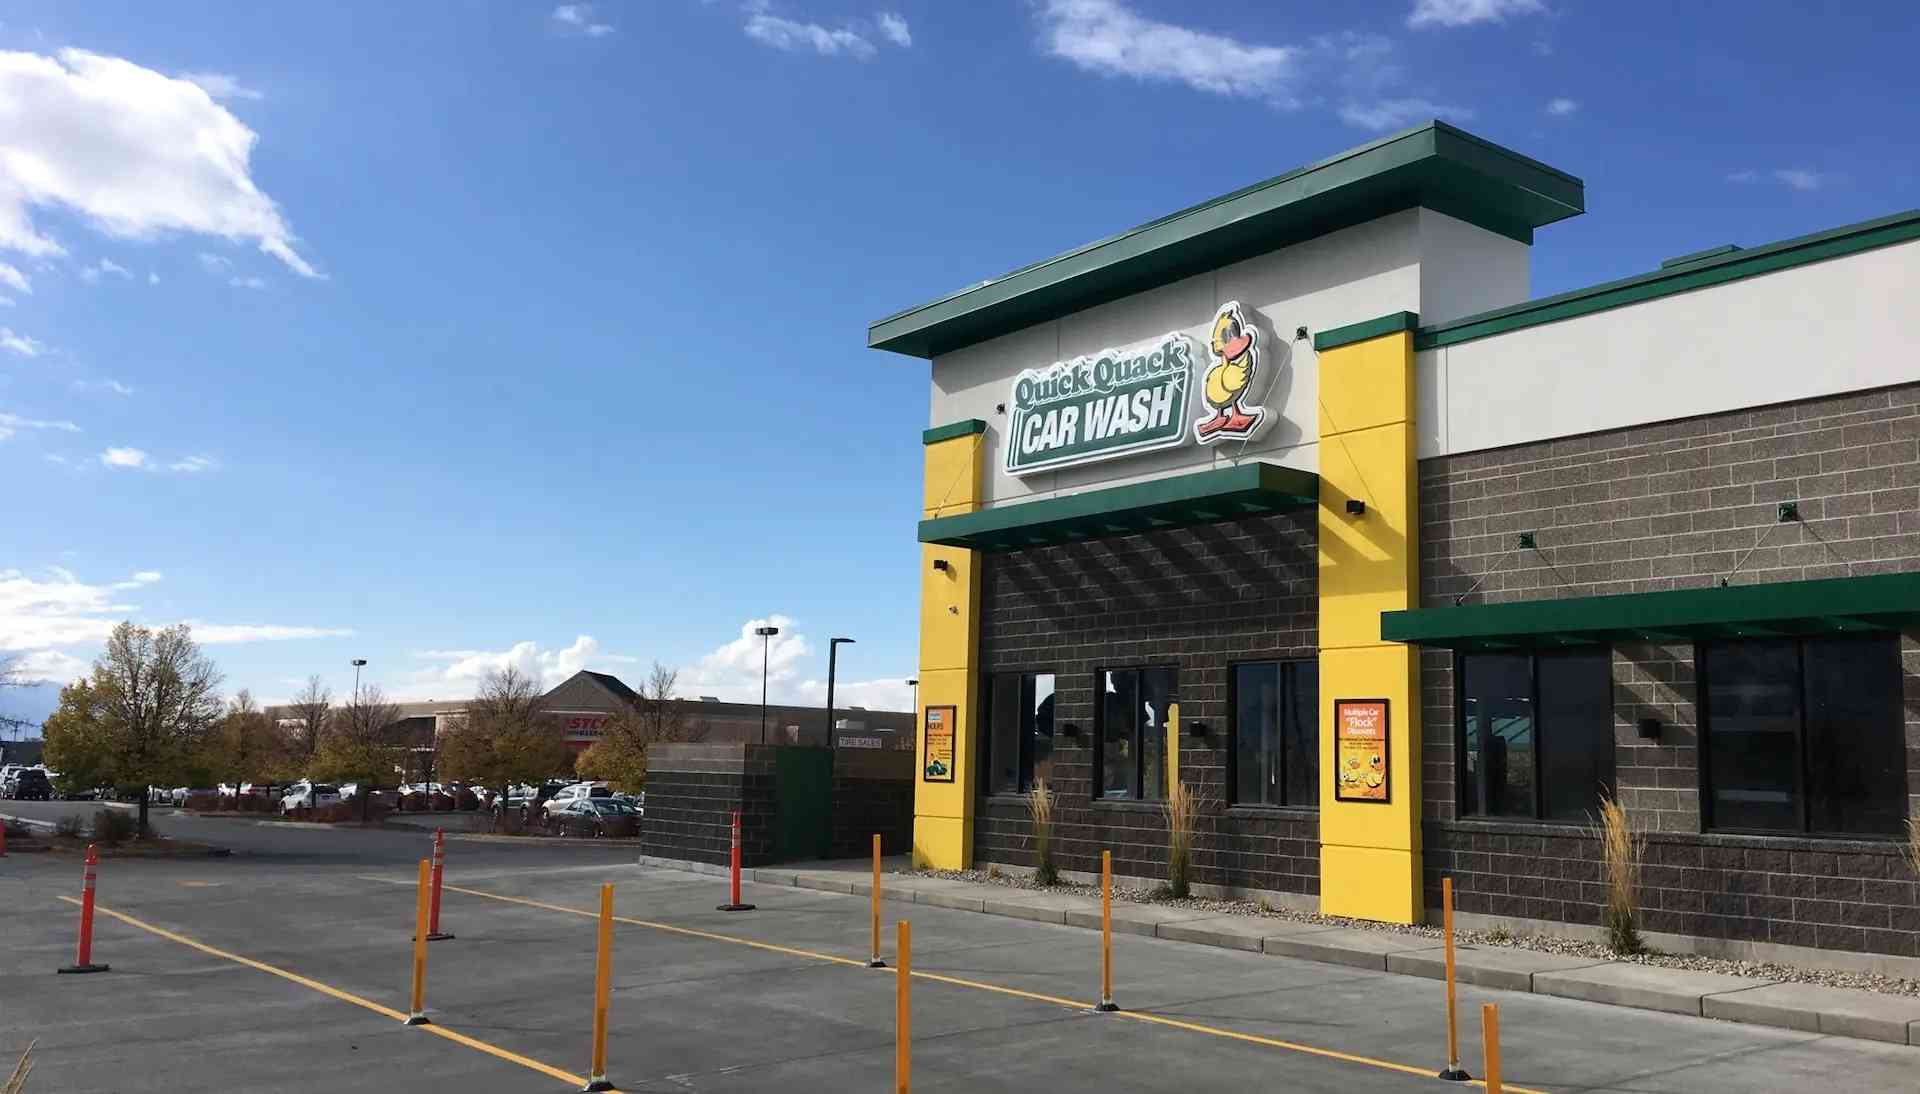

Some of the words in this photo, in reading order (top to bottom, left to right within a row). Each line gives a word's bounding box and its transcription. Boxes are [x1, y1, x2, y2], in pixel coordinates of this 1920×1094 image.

[1016, 364, 1091, 410] Quick
[1093, 341, 1187, 391] Quack
[1022, 406, 1079, 454] CAR
[1084, 385, 1175, 442] WASH
